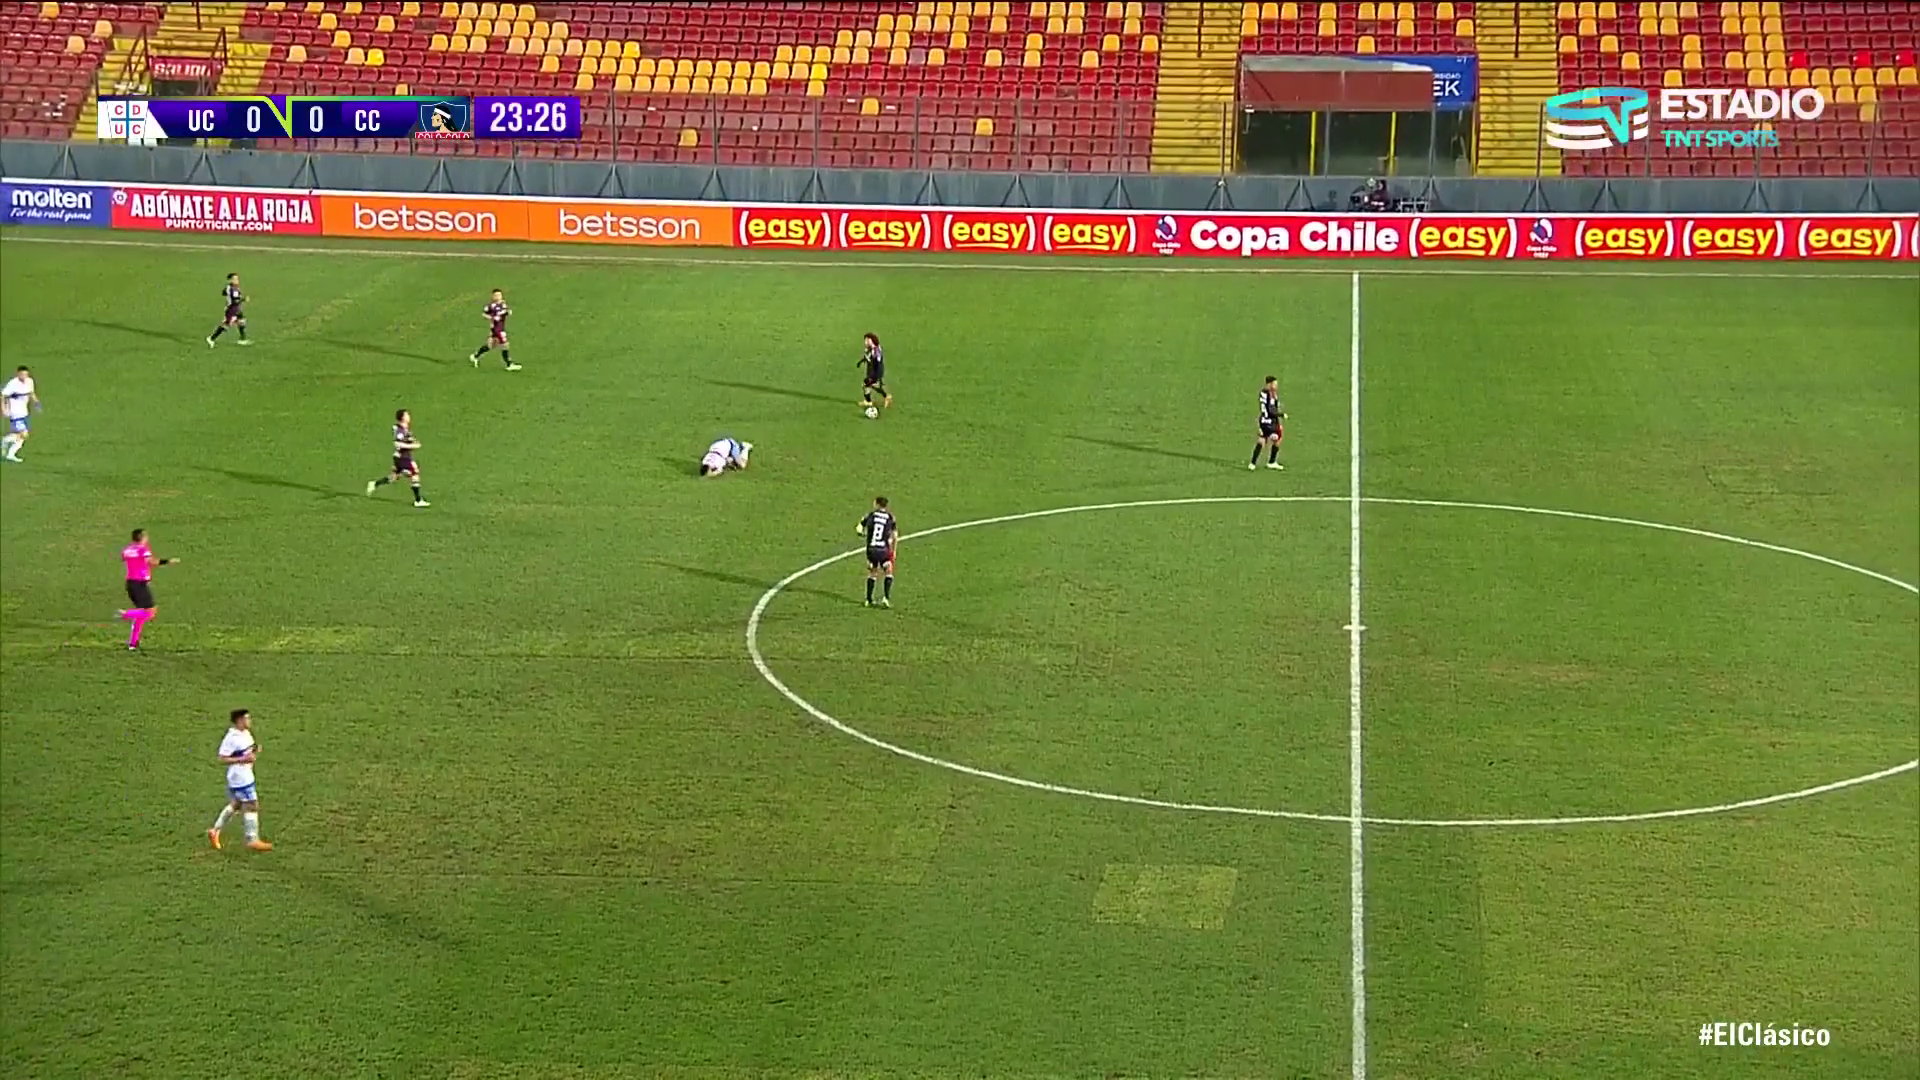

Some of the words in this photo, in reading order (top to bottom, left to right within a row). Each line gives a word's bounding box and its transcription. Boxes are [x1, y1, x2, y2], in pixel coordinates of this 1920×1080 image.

[12, 187, 92, 209] molten
[130, 191, 214, 220] ABÓNATE
[219, 197, 232, 221] A
[236, 197, 260, 222] LA
[262, 198, 314, 224] ROJA
[10, 207, 26, 217] For
[27, 208, 42, 218] the
[43, 209, 65, 219] real
[65, 212, 91, 222] game
[166, 219, 272, 232] PUNTOTICKET.COM
[354, 202, 496, 233] betsson
[559, 209, 700, 240] betsson
[1190, 219, 1290, 257] Copa
[1299, 219, 1399, 252] Chile
